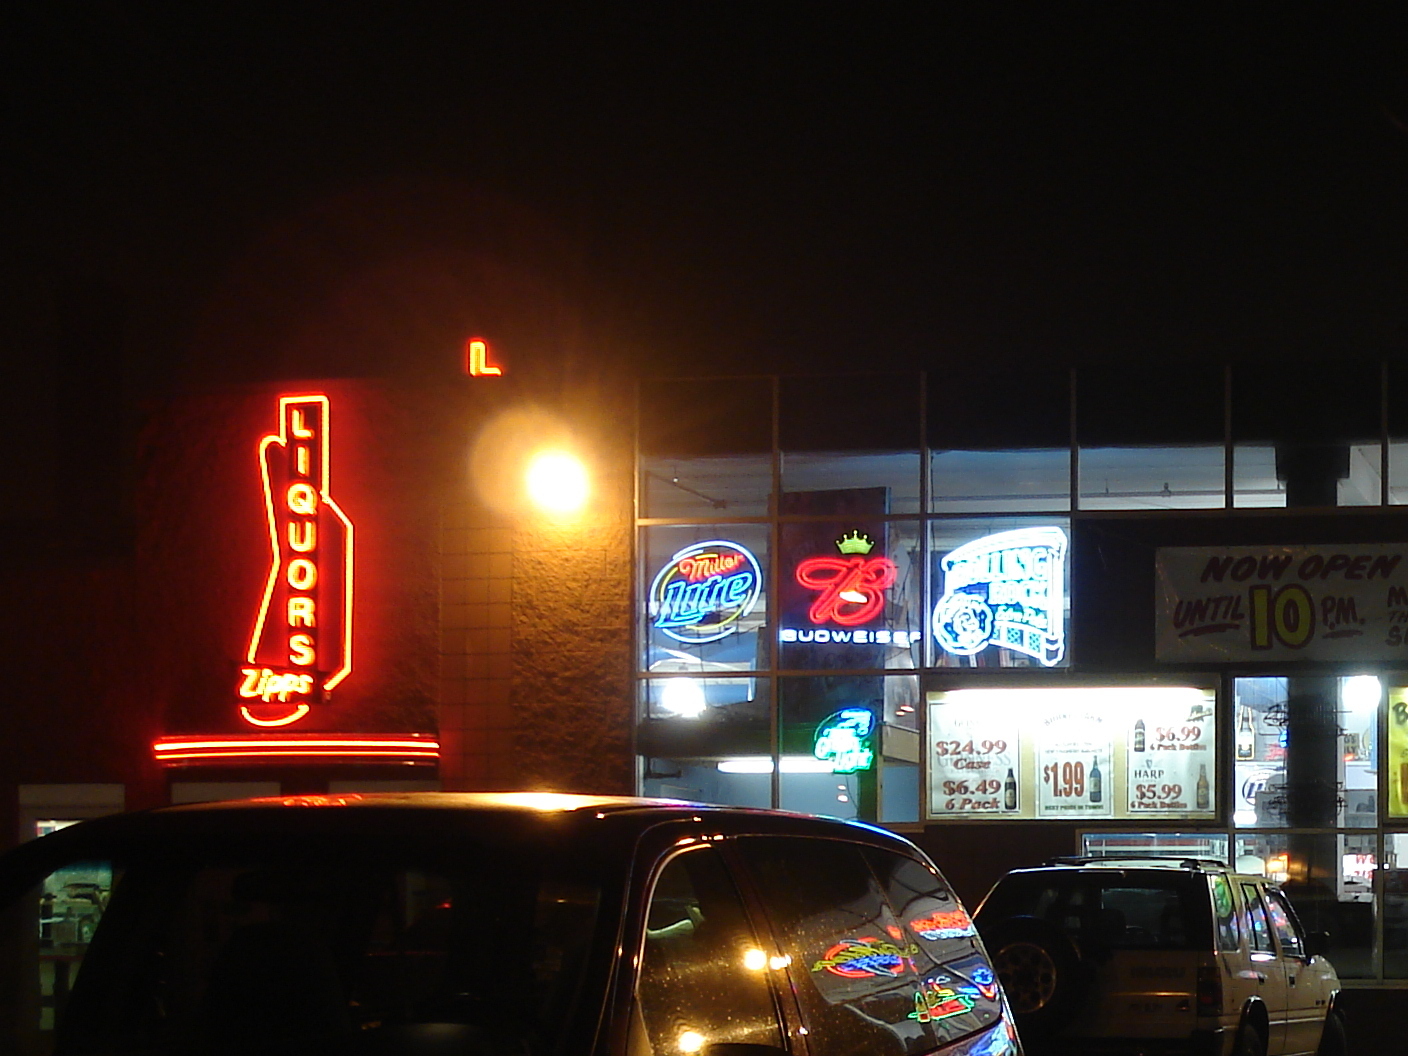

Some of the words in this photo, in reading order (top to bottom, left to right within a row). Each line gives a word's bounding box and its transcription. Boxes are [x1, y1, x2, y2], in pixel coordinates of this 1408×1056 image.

[286, 407, 318, 667] LIQUORS
[678, 552, 746, 583] Miller
[1200, 555, 1293, 583] NOW
[1297, 553, 1402, 581] OPEN
[654, 572, 753, 628] Lite
[1173, 595, 1246, 630] UNTIL
[1249, 583, 1317, 651] 10
[239, 667, 314, 703] Zipps
[1155, 726, 1202, 742] $6.99
[935, 740, 1008, 757] $24.99
[953, 758, 992, 770] Case
[1134, 769, 1165, 781] HARP
[943, 779, 1002, 796] $6.49
[1043, 761, 1085, 798] $1.99
[945, 798, 956, 811] 6
[959, 797, 1001, 811] Pack
[1135, 783, 1183, 801] $5.99
